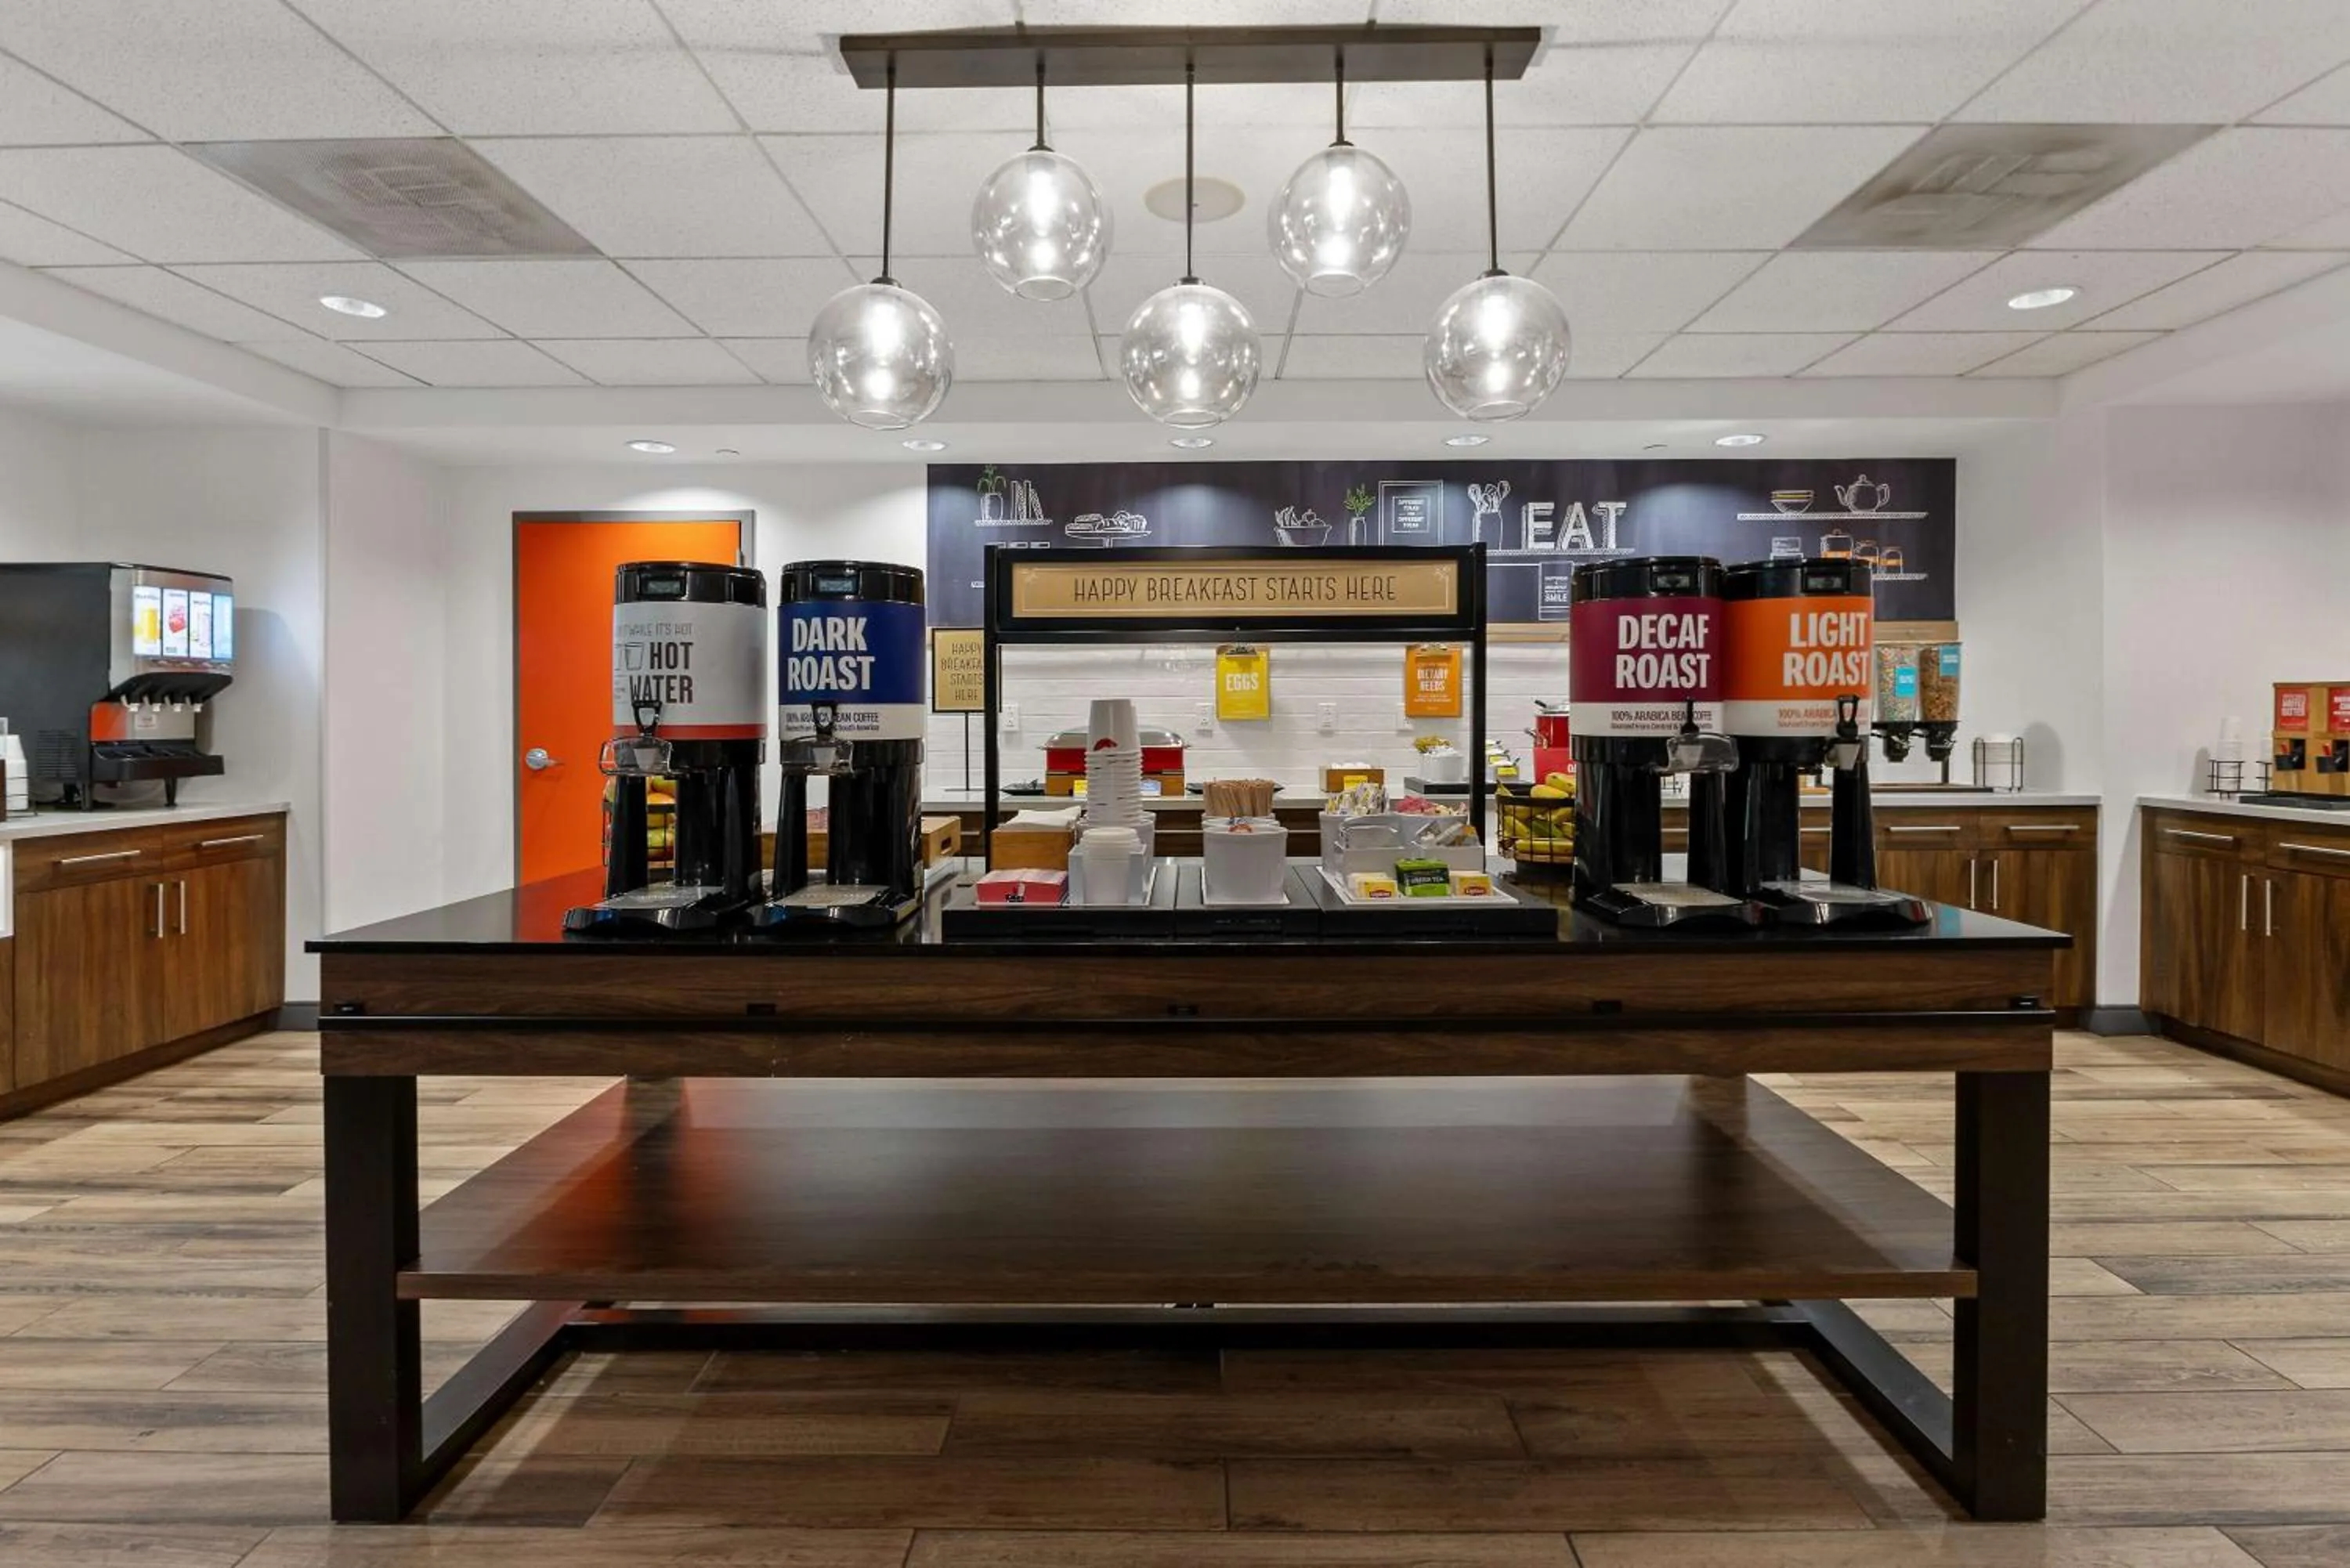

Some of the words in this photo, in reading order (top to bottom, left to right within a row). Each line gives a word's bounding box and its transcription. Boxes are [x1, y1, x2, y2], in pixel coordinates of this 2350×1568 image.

[1521, 501, 1627, 549] EAT
[1074, 576, 1137, 602] HAPPY
[1147, 576, 1258, 602] BREAKFAST
[1265, 576, 1337, 602] STARTS
[1347, 576, 1397, 601] HERE
[674, 623, 692, 635] HOT
[792, 616, 868, 652] DARK
[1618, 613, 1710, 650] DECAF
[1790, 612, 1868, 648] LIGHT
[649, 641, 694, 670] HOT
[952, 642, 982, 656] HAPPY
[787, 656, 876, 692] ROAST
[941, 657, 984, 671] BREAKFA
[1615, 653, 1712, 689] ROAST
[1782, 651, 1870, 688] ROAST
[629, 674, 694, 704] WATER
[1225, 672, 1260, 692] EGGS
[833, 712, 851, 722] EAN
[852, 712, 879, 722] COFFEE
[1611, 710, 1633, 721] 100%
[1635, 710, 1669, 721] ARABICA
[1671, 710, 1688, 721] BEA
